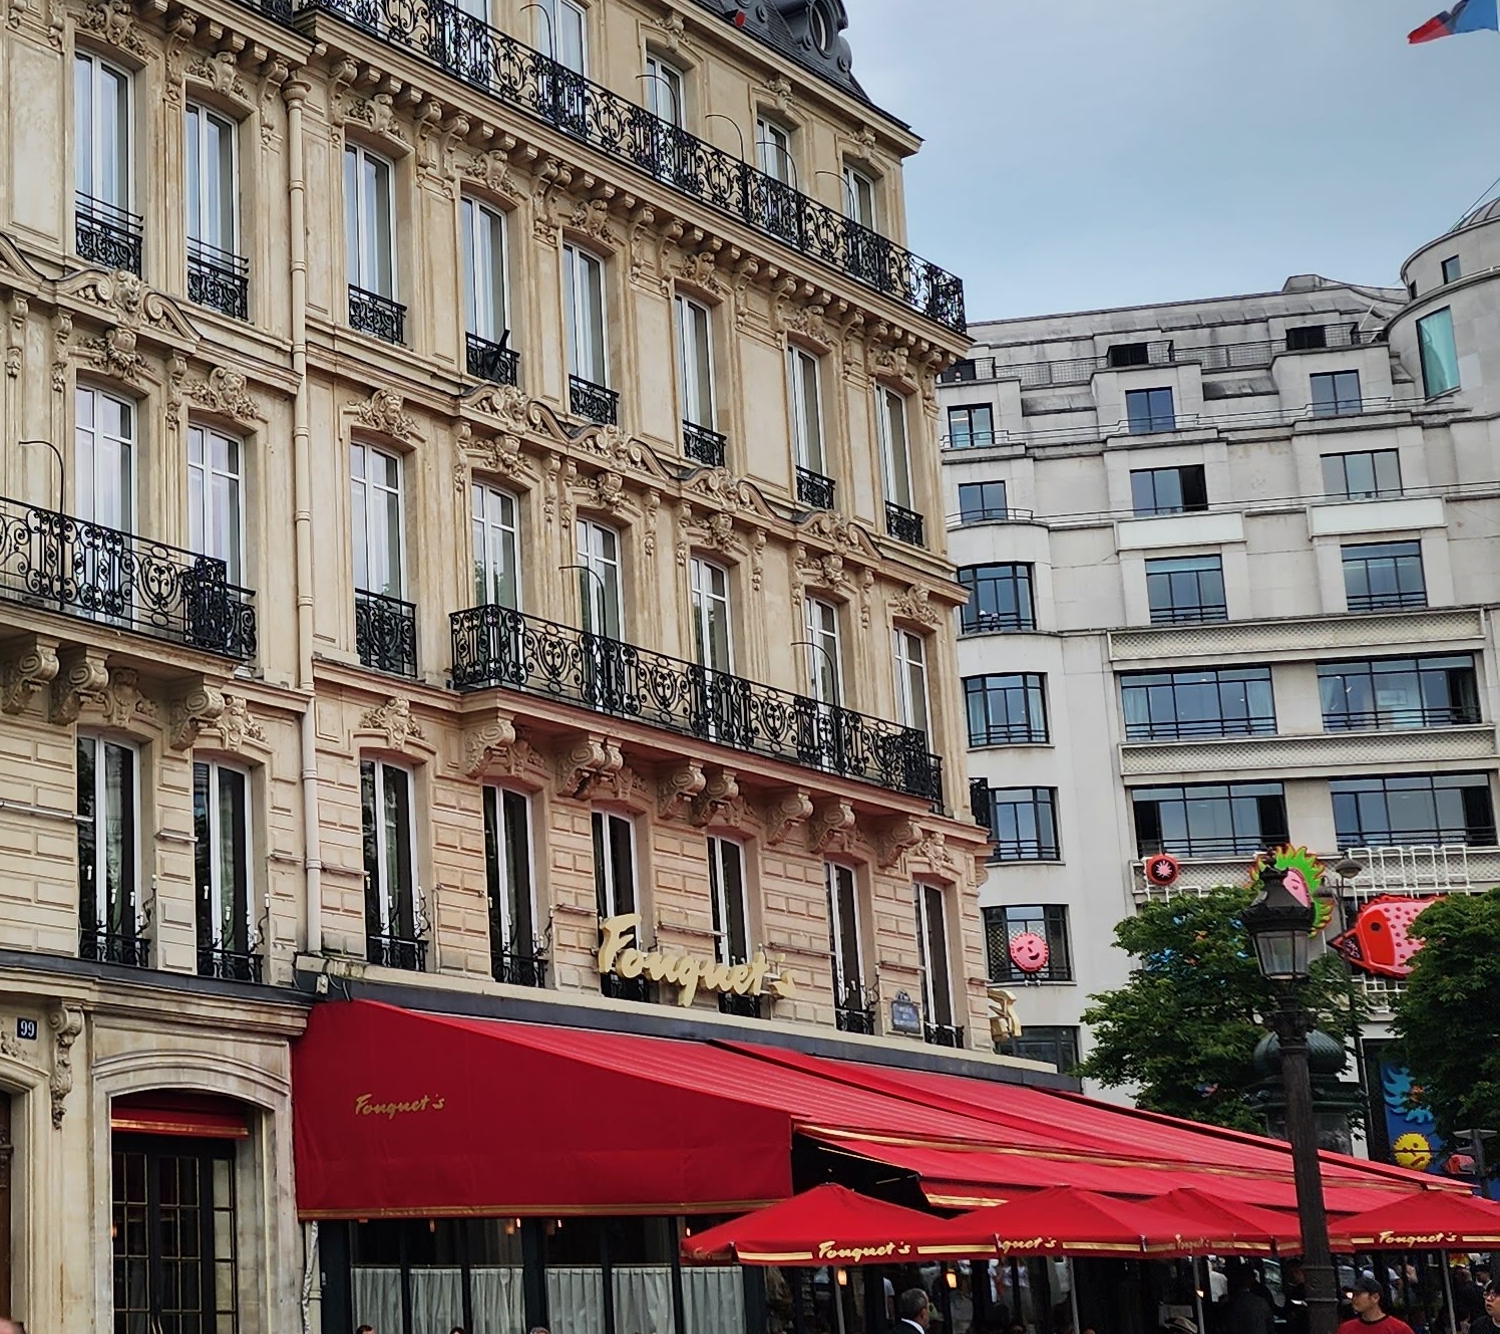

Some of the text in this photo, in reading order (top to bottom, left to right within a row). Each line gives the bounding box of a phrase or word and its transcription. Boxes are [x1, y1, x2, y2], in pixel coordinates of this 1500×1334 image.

[598, 913, 798, 1007] Fouquet's
[20, 1020, 35, 1037] 99
[355, 1093, 445, 1120] Fouquet's
[1379, 1230, 1458, 1248] Fouquet's
[818, 1240, 911, 1263] Fouquet's
